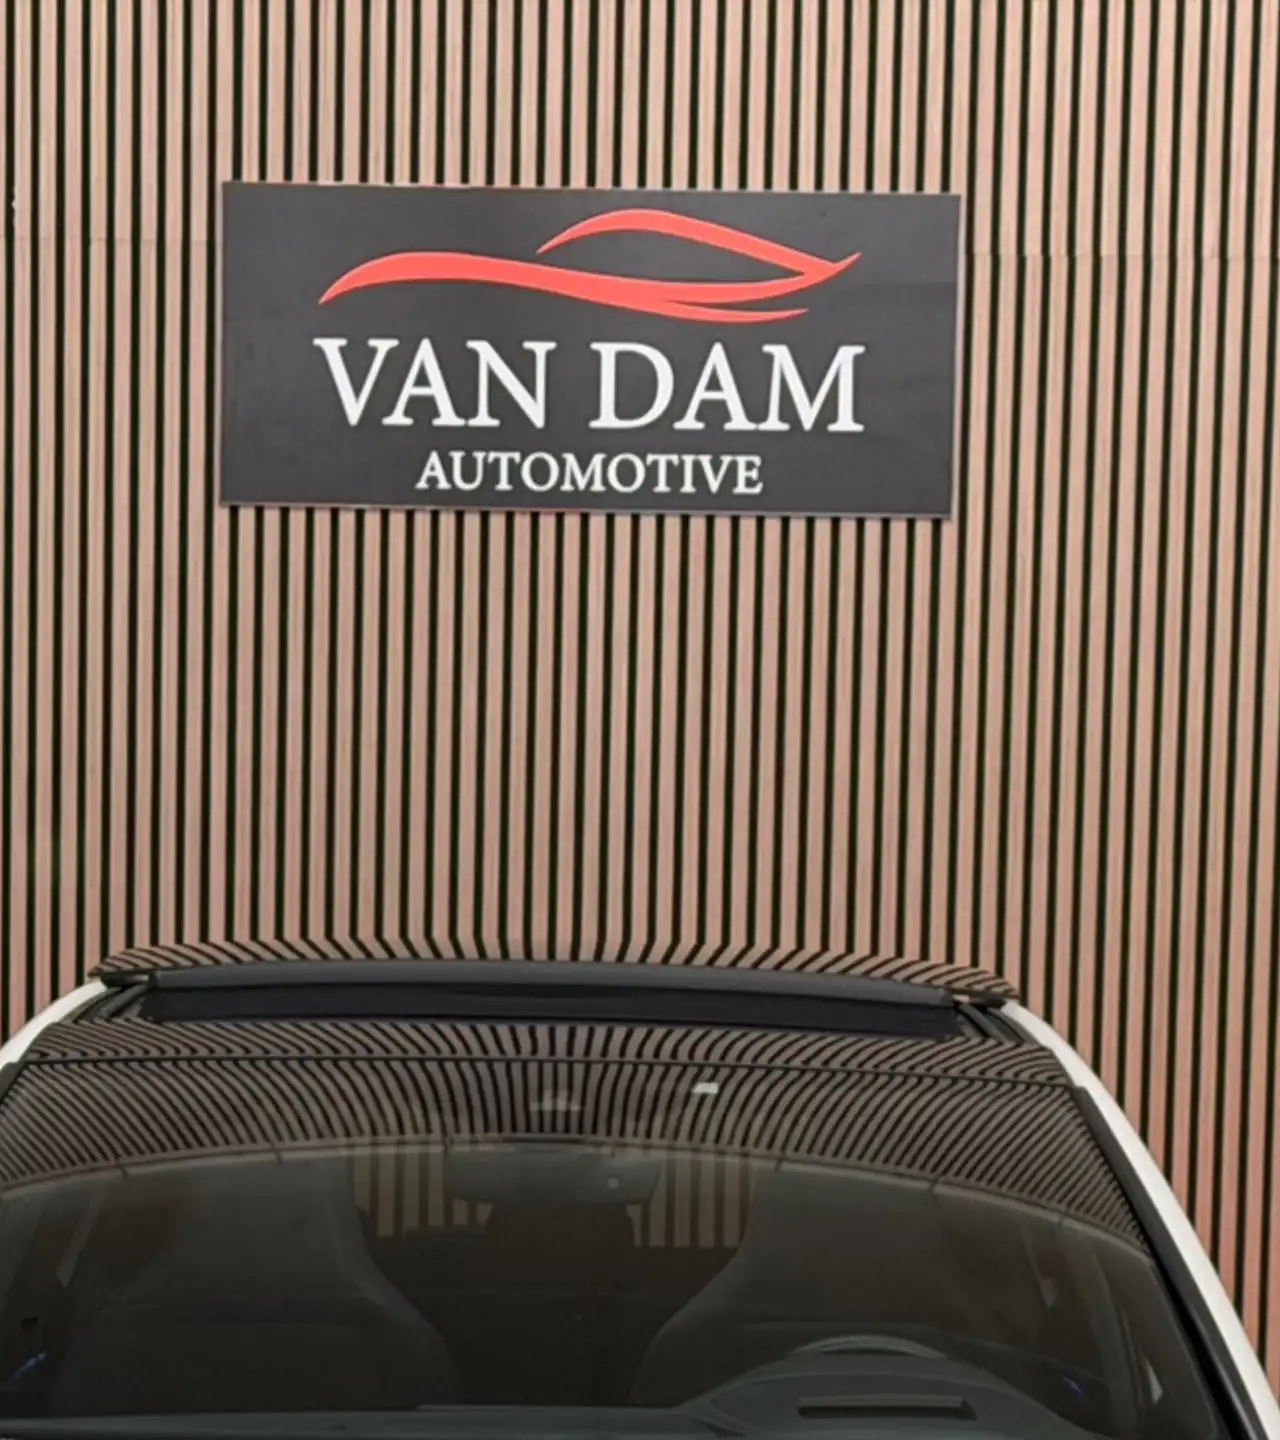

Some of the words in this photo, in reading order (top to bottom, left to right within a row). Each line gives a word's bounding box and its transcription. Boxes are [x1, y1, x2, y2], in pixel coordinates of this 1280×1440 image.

[313, 337, 557, 429] VAN
[588, 340, 867, 433] DAM
[415, 450, 764, 495] AUTOMOTIVE
